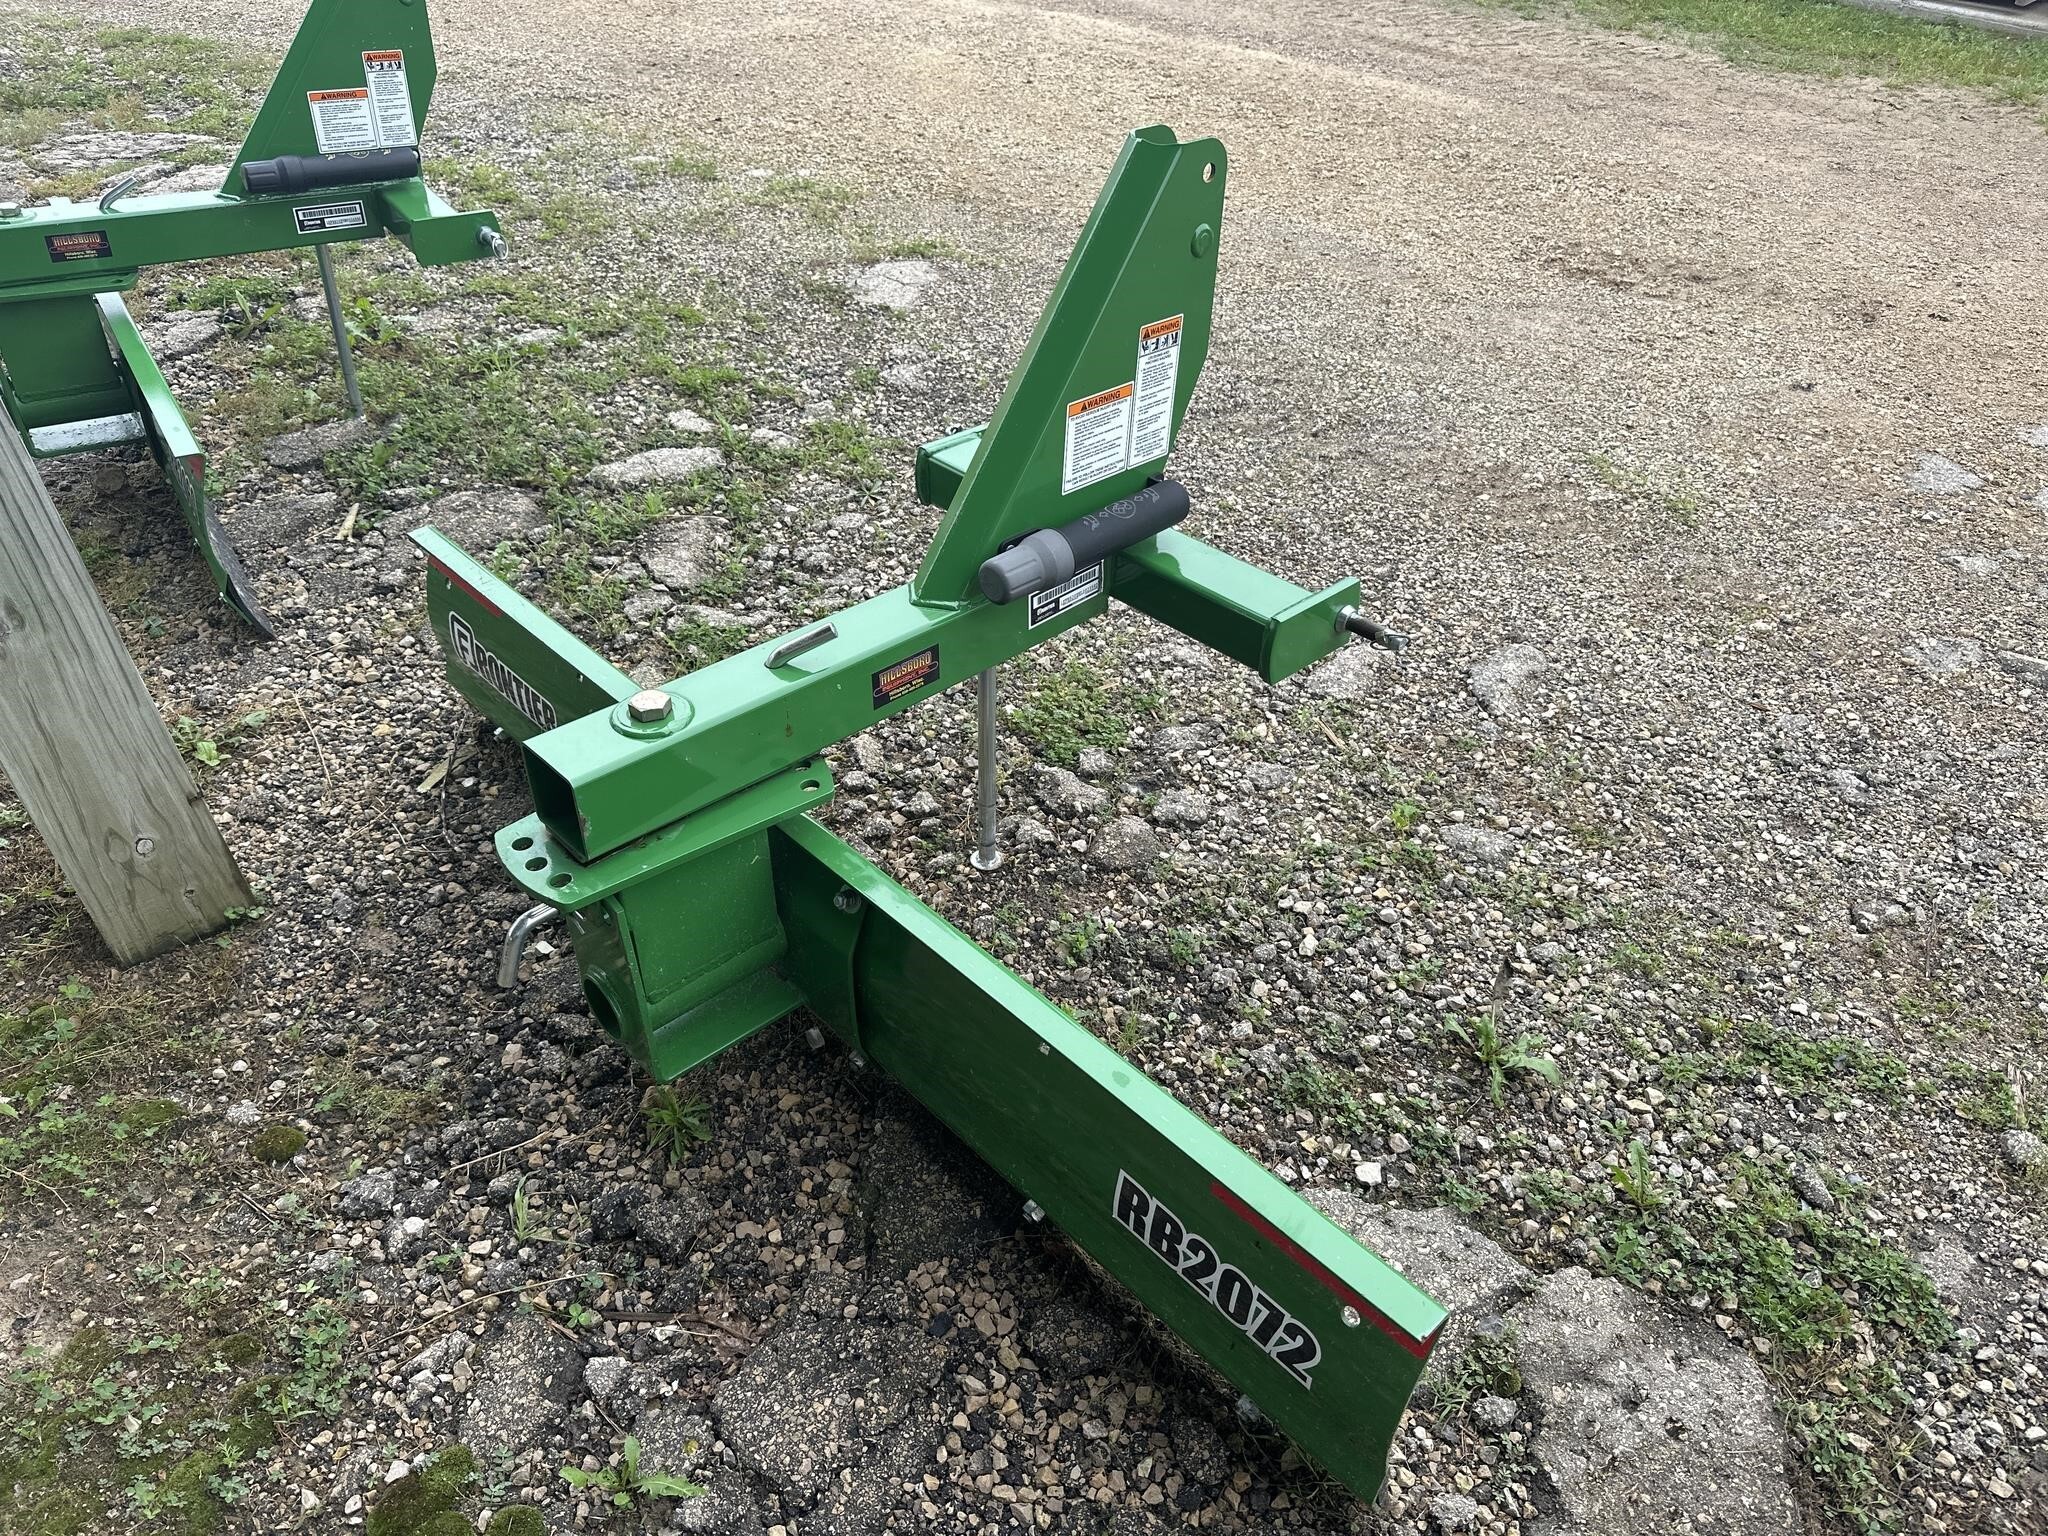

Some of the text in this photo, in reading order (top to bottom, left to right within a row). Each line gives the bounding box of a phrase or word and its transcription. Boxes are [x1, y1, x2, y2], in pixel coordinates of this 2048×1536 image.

[326, 92, 357, 100] WARNING
[53, 234, 100, 247] HILLSBORO
[1150, 320, 1180, 336] WARNING
[1087, 390, 1121, 409] WARNING
[449, 611, 558, 732] FRONTIER
[879, 651, 933, 687] HILLSBORO
[1112, 1168, 1322, 1391] RB2072
